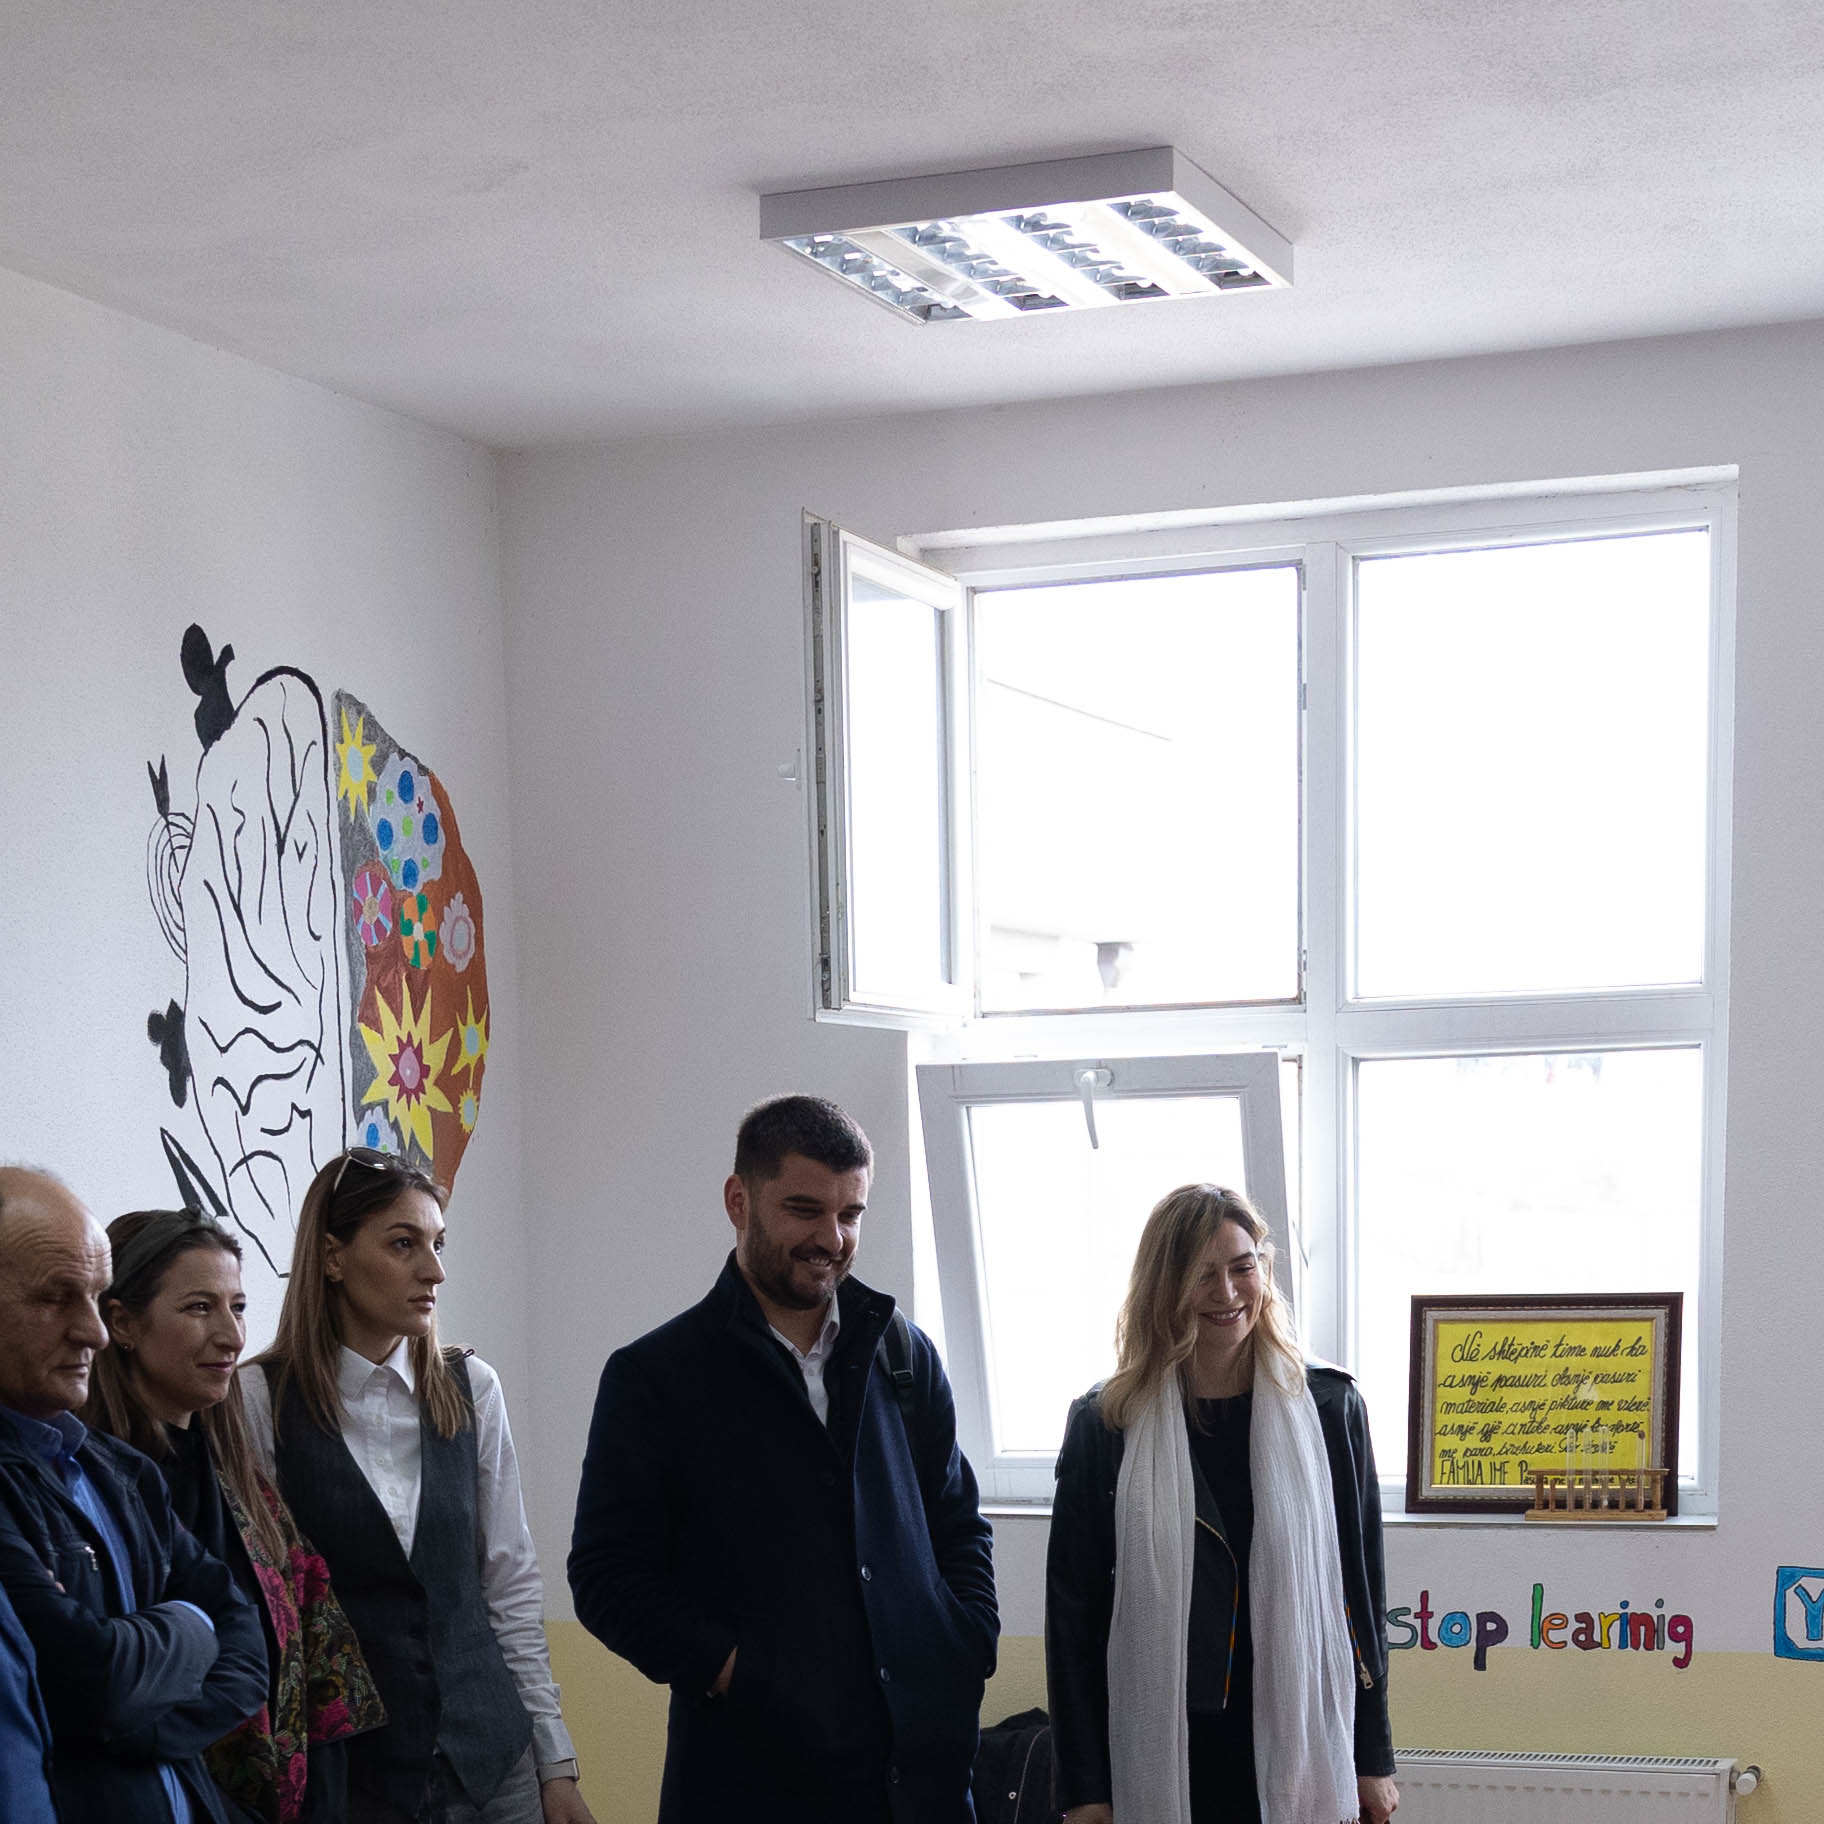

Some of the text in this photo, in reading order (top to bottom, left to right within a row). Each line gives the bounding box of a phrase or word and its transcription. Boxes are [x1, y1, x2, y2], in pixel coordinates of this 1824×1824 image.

[1551, 1334, 1587, 1359] time
[1386, 1590, 1509, 1671] stop
[1530, 1583, 1694, 1669] learinig
